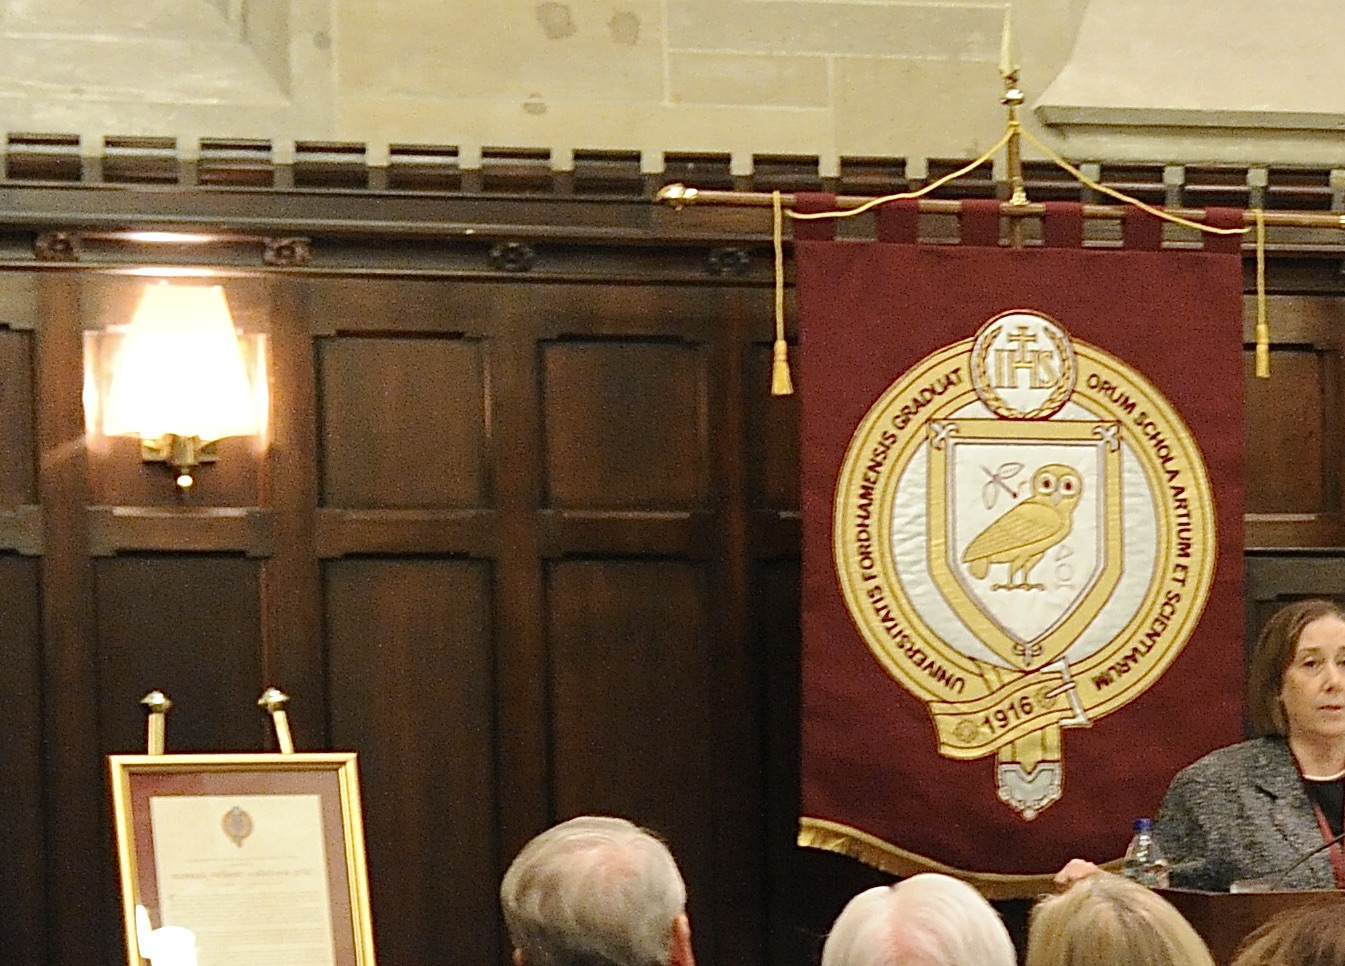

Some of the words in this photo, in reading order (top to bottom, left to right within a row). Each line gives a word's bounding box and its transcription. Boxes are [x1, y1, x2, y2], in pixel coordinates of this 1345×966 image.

[891, 366, 964, 430] GRADUAT
[993, 347, 1056, 390] IHS
[1086, 372, 1136, 418] ORUM
[1134, 412, 1182, 482] SCHOLA
[857, 430, 898, 581] FORDHAMENSIS
[1170, 484, 1193, 559] ARTIUM
[1170, 563, 1191, 587] ET
[860, 586, 966, 695] UNIVERSITATIS
[1094, 589, 1182, 692] SCIENTIARUM
[982, 696, 1034, 736] 1916
